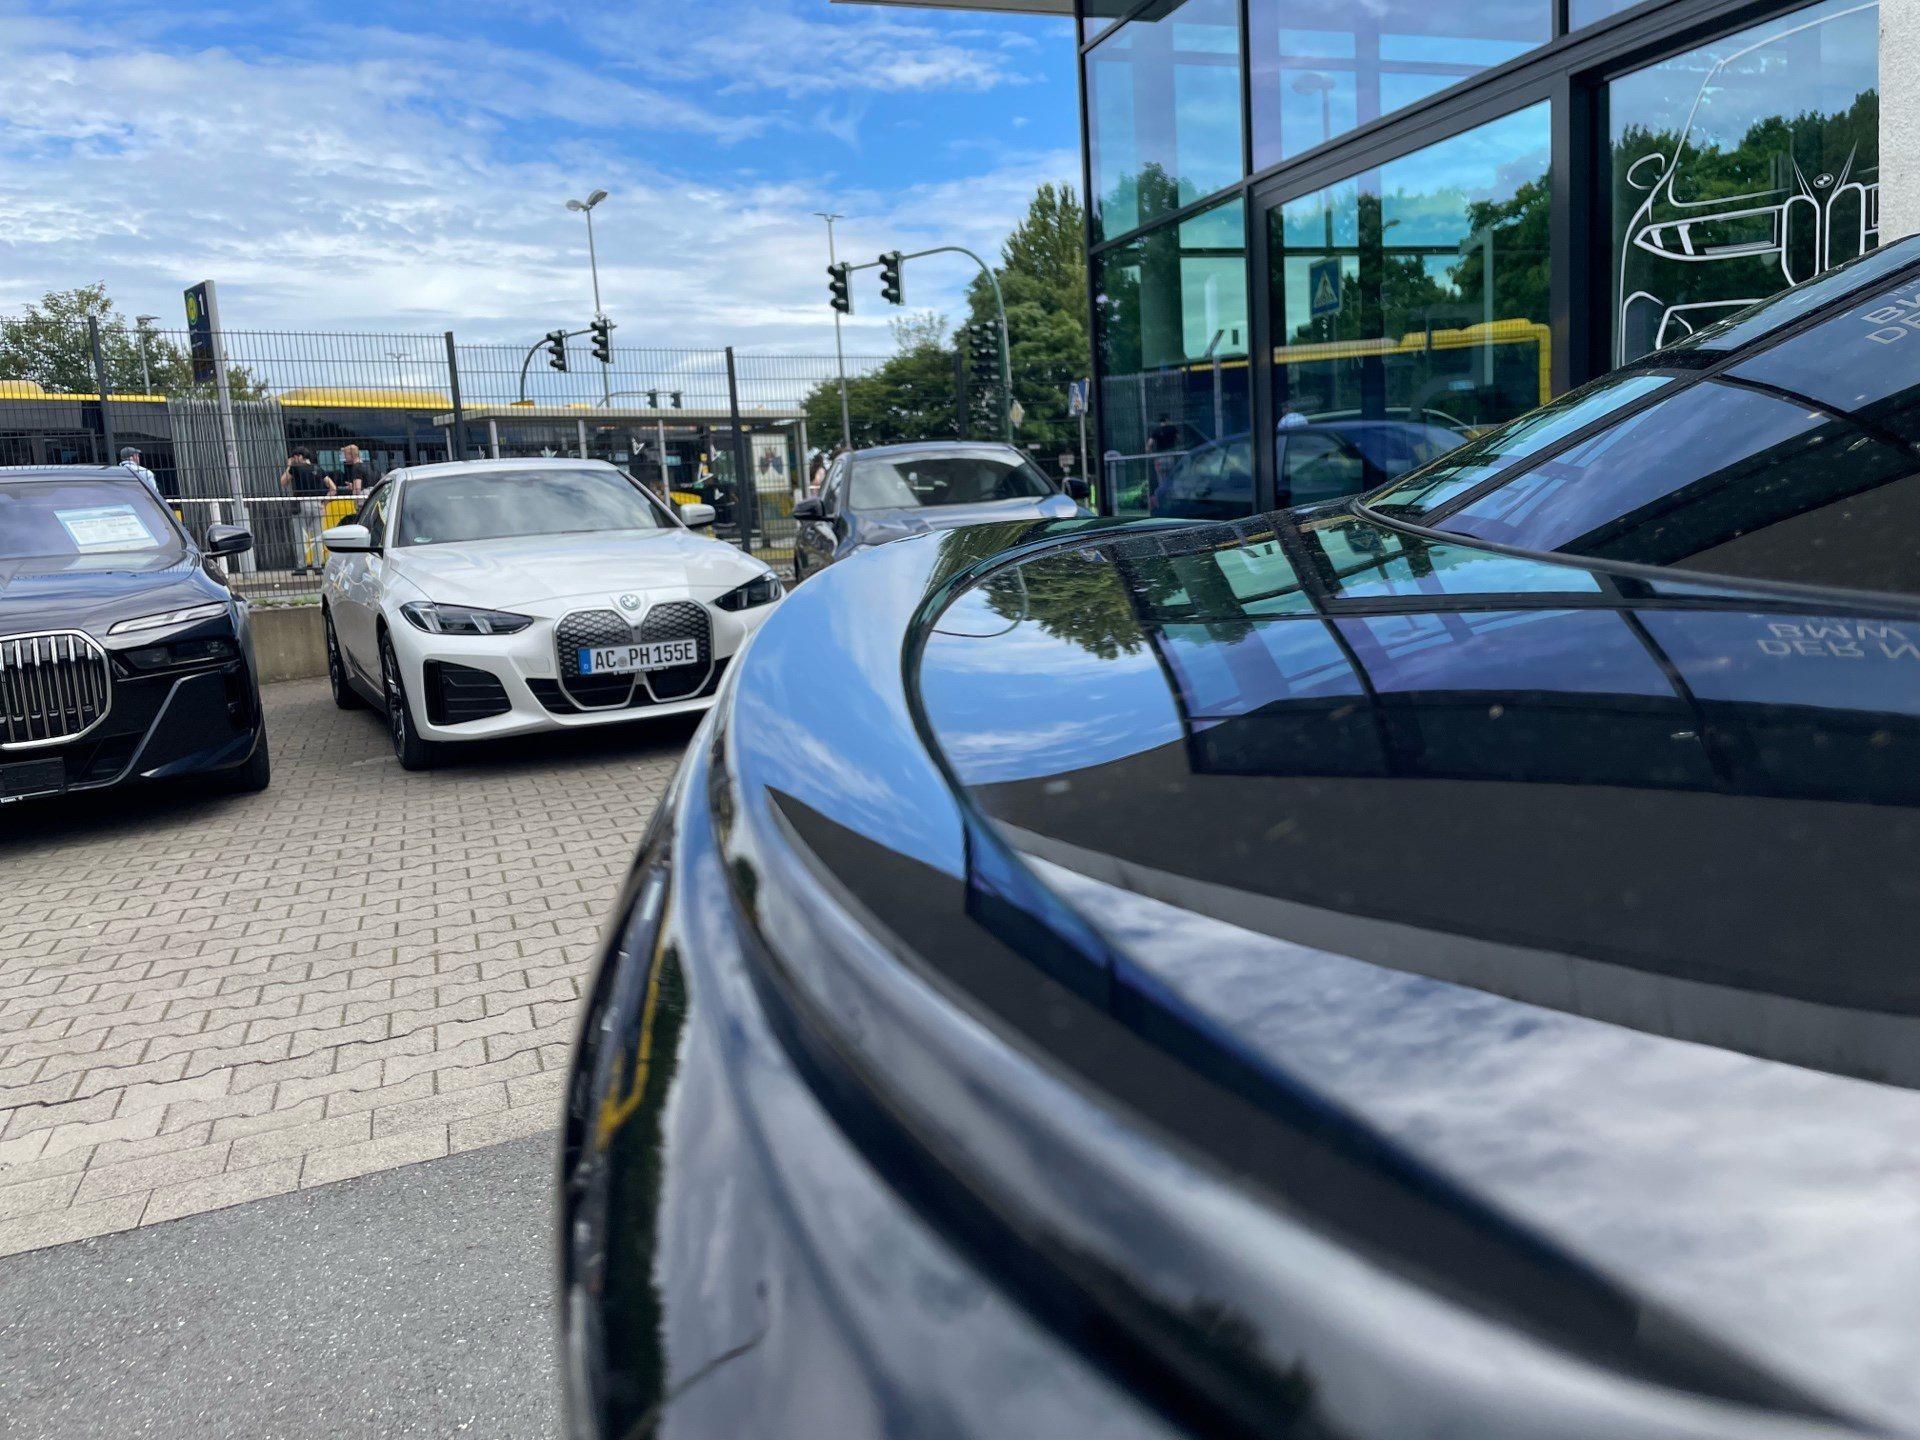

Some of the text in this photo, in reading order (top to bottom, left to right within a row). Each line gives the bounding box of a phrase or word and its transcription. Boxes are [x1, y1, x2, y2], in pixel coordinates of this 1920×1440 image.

[198, 293, 205, 316] 1
[595, 650, 616, 670] AC
[628, 646, 650, 666] PH
[653, 642, 694, 663] 155E
